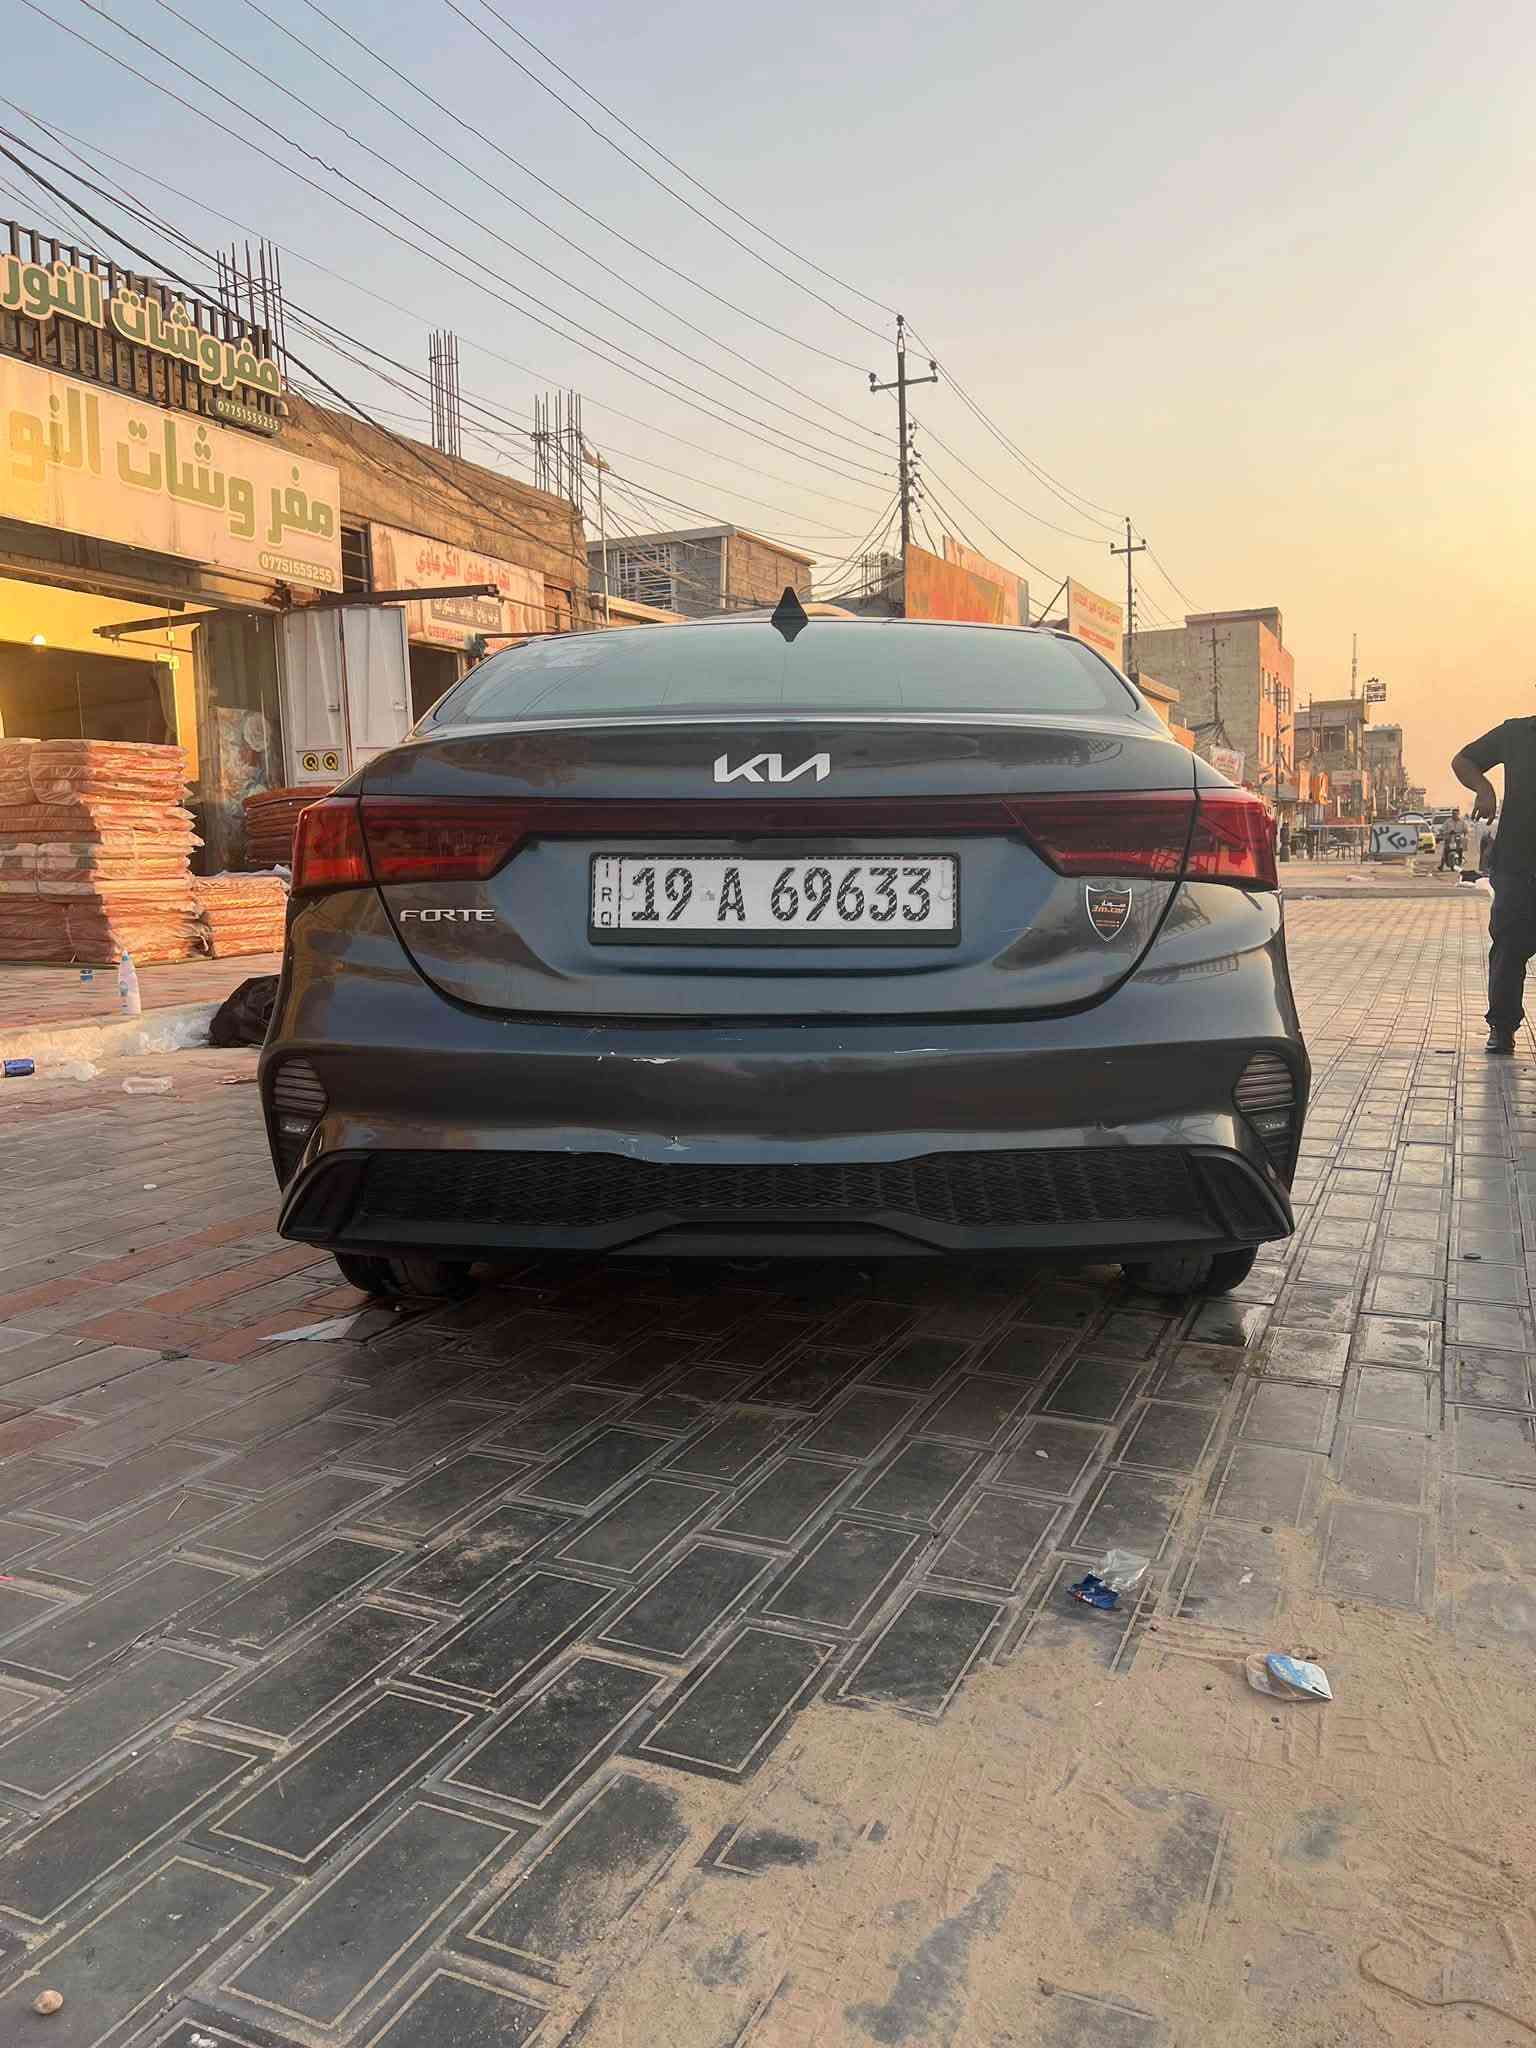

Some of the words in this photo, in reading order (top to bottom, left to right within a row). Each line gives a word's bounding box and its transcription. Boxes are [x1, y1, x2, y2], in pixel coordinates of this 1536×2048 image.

[0, 257, 102, 325] النور
[110, 288, 281, 396] مفروشات
[9, 386, 102, 483] النو
[217, 400, 280, 431] 07751555255
[116, 418, 335, 546] مفروشات
[261, 552, 333, 583] 07751555255
[714, 753, 830, 782] KIA
[400, 909, 496, 922] FORTE
[600, 862, 613, 927] IRQ
[631, 867, 692, 921] 19
[717, 867, 746, 921] A
[771, 867, 931, 921] 69633
